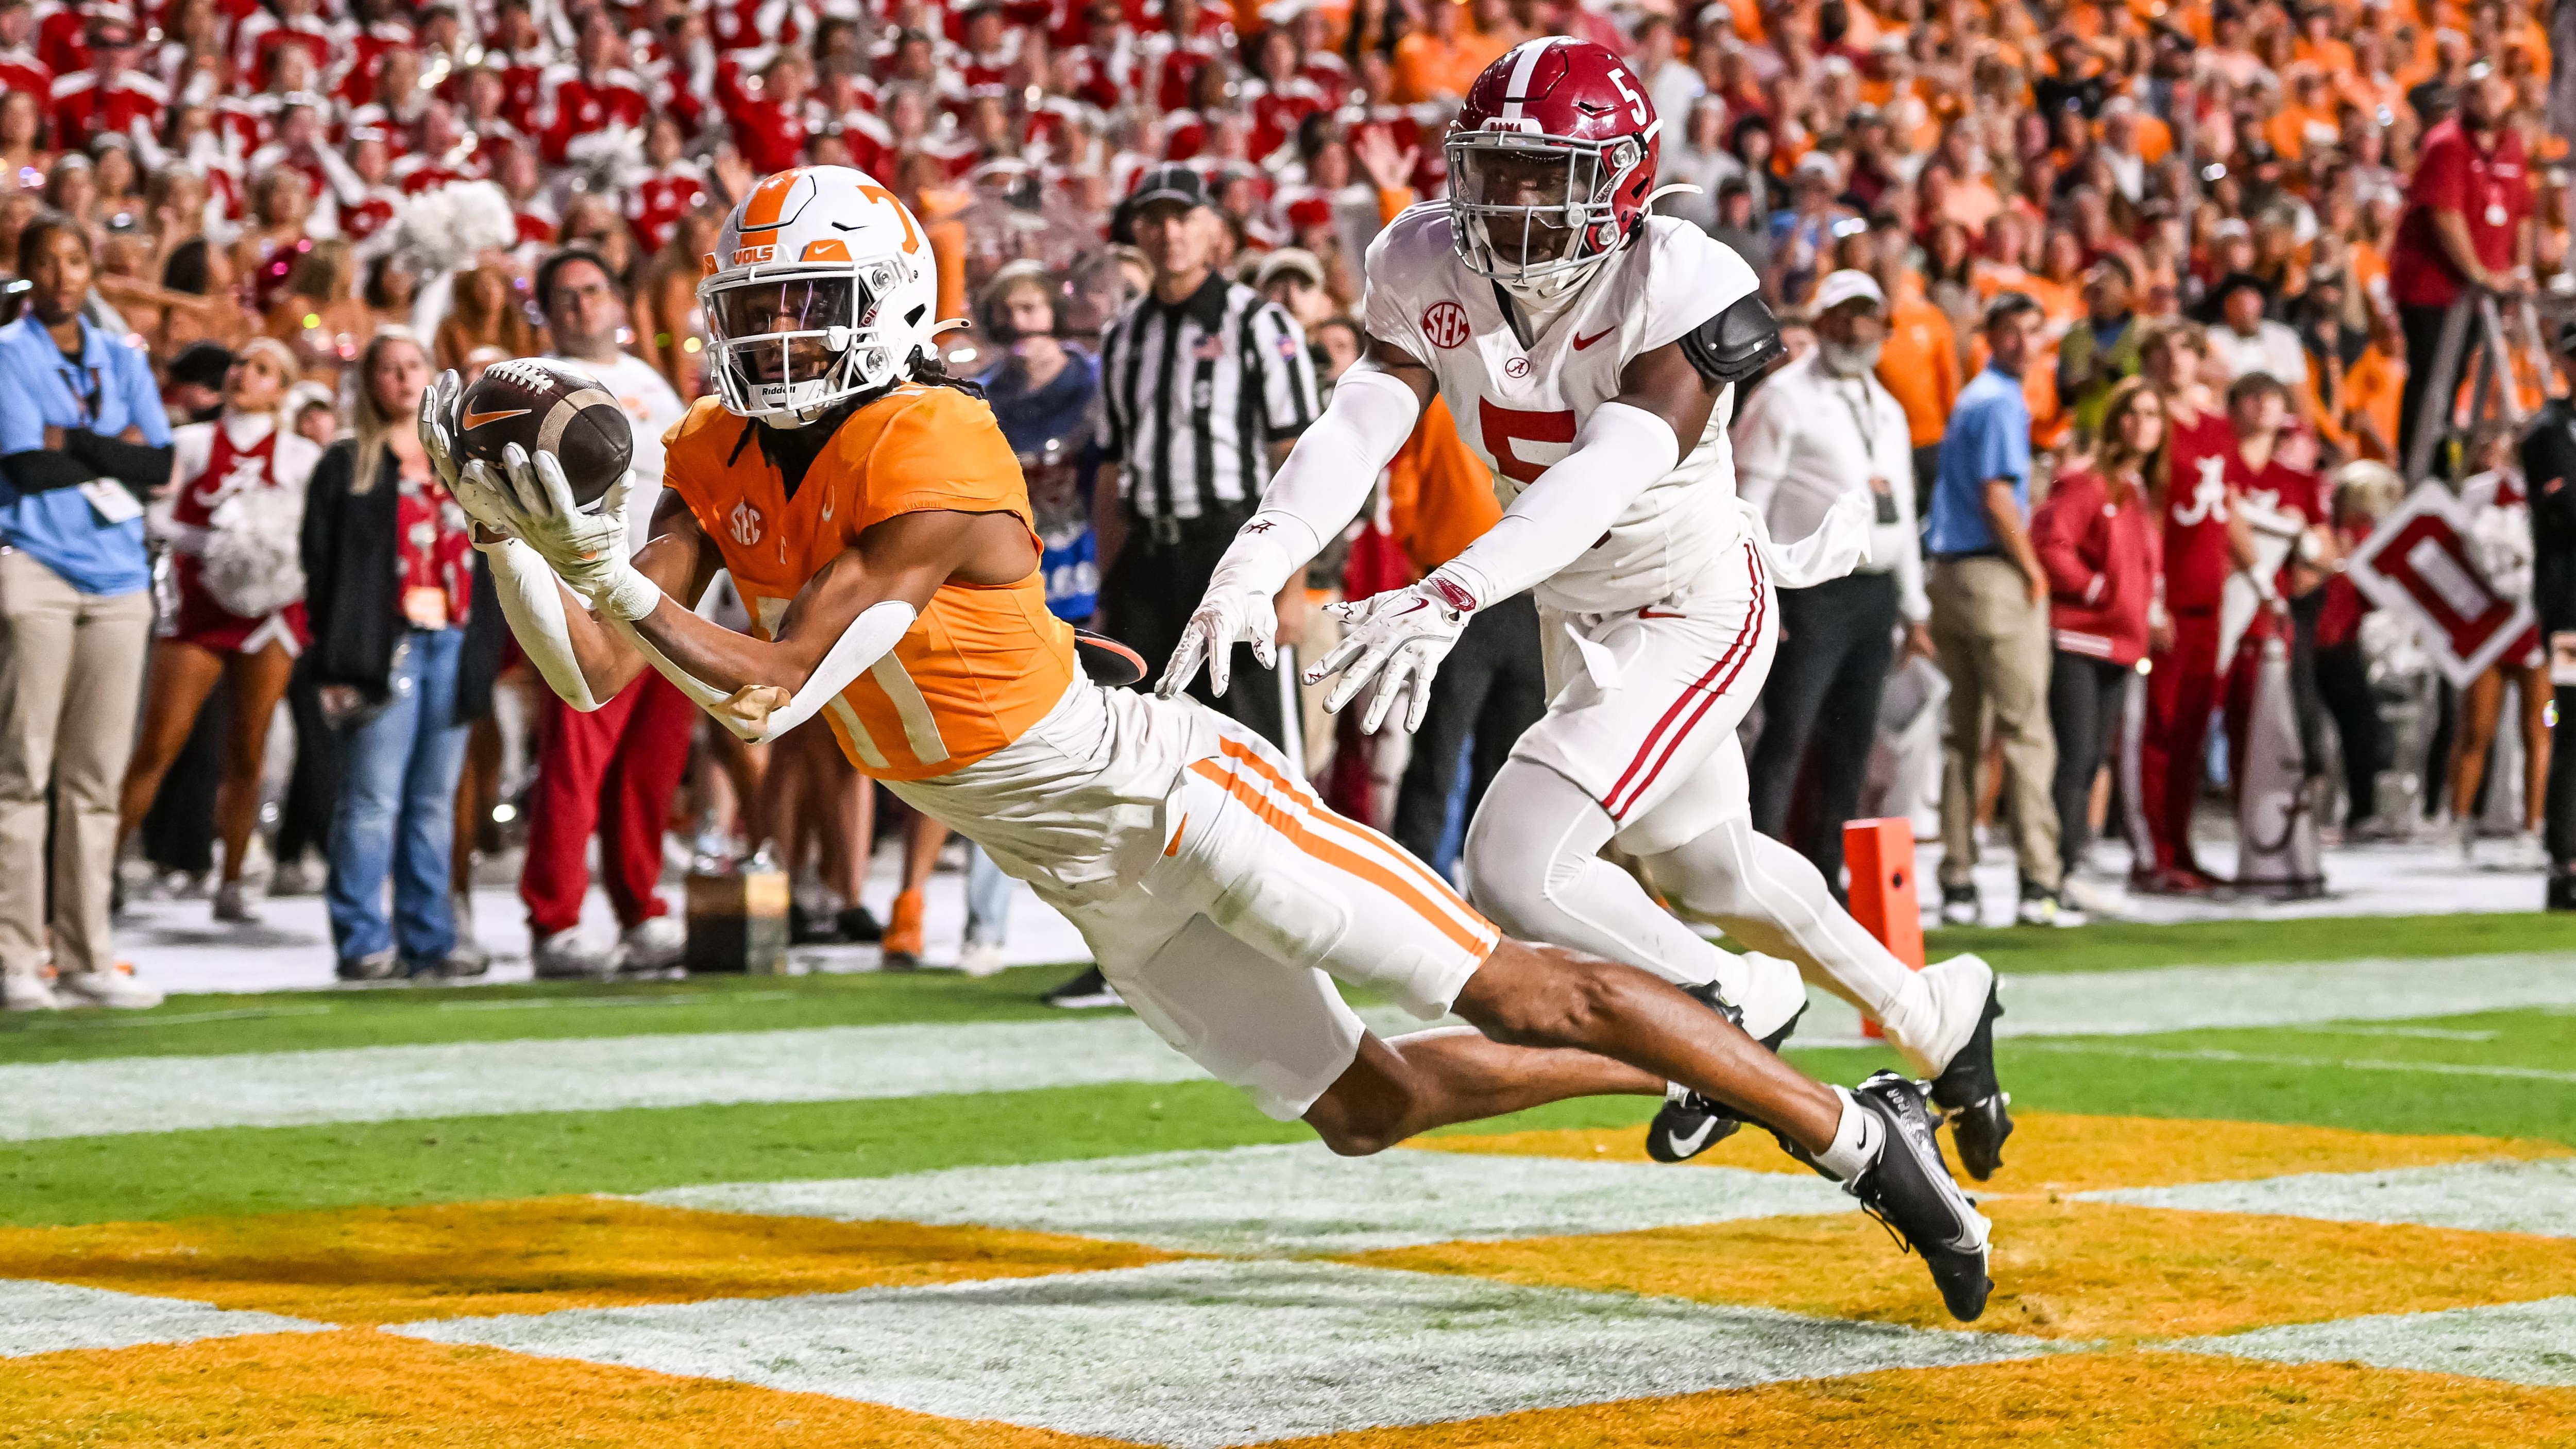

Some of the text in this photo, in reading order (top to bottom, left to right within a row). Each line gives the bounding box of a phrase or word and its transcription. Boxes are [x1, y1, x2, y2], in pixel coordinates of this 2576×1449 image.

[1606, 67, 1647, 126] 5
[733, 247, 773, 265] VOLS
[1426, 304, 1467, 346] SEC
[730, 502, 761, 545] SEC
